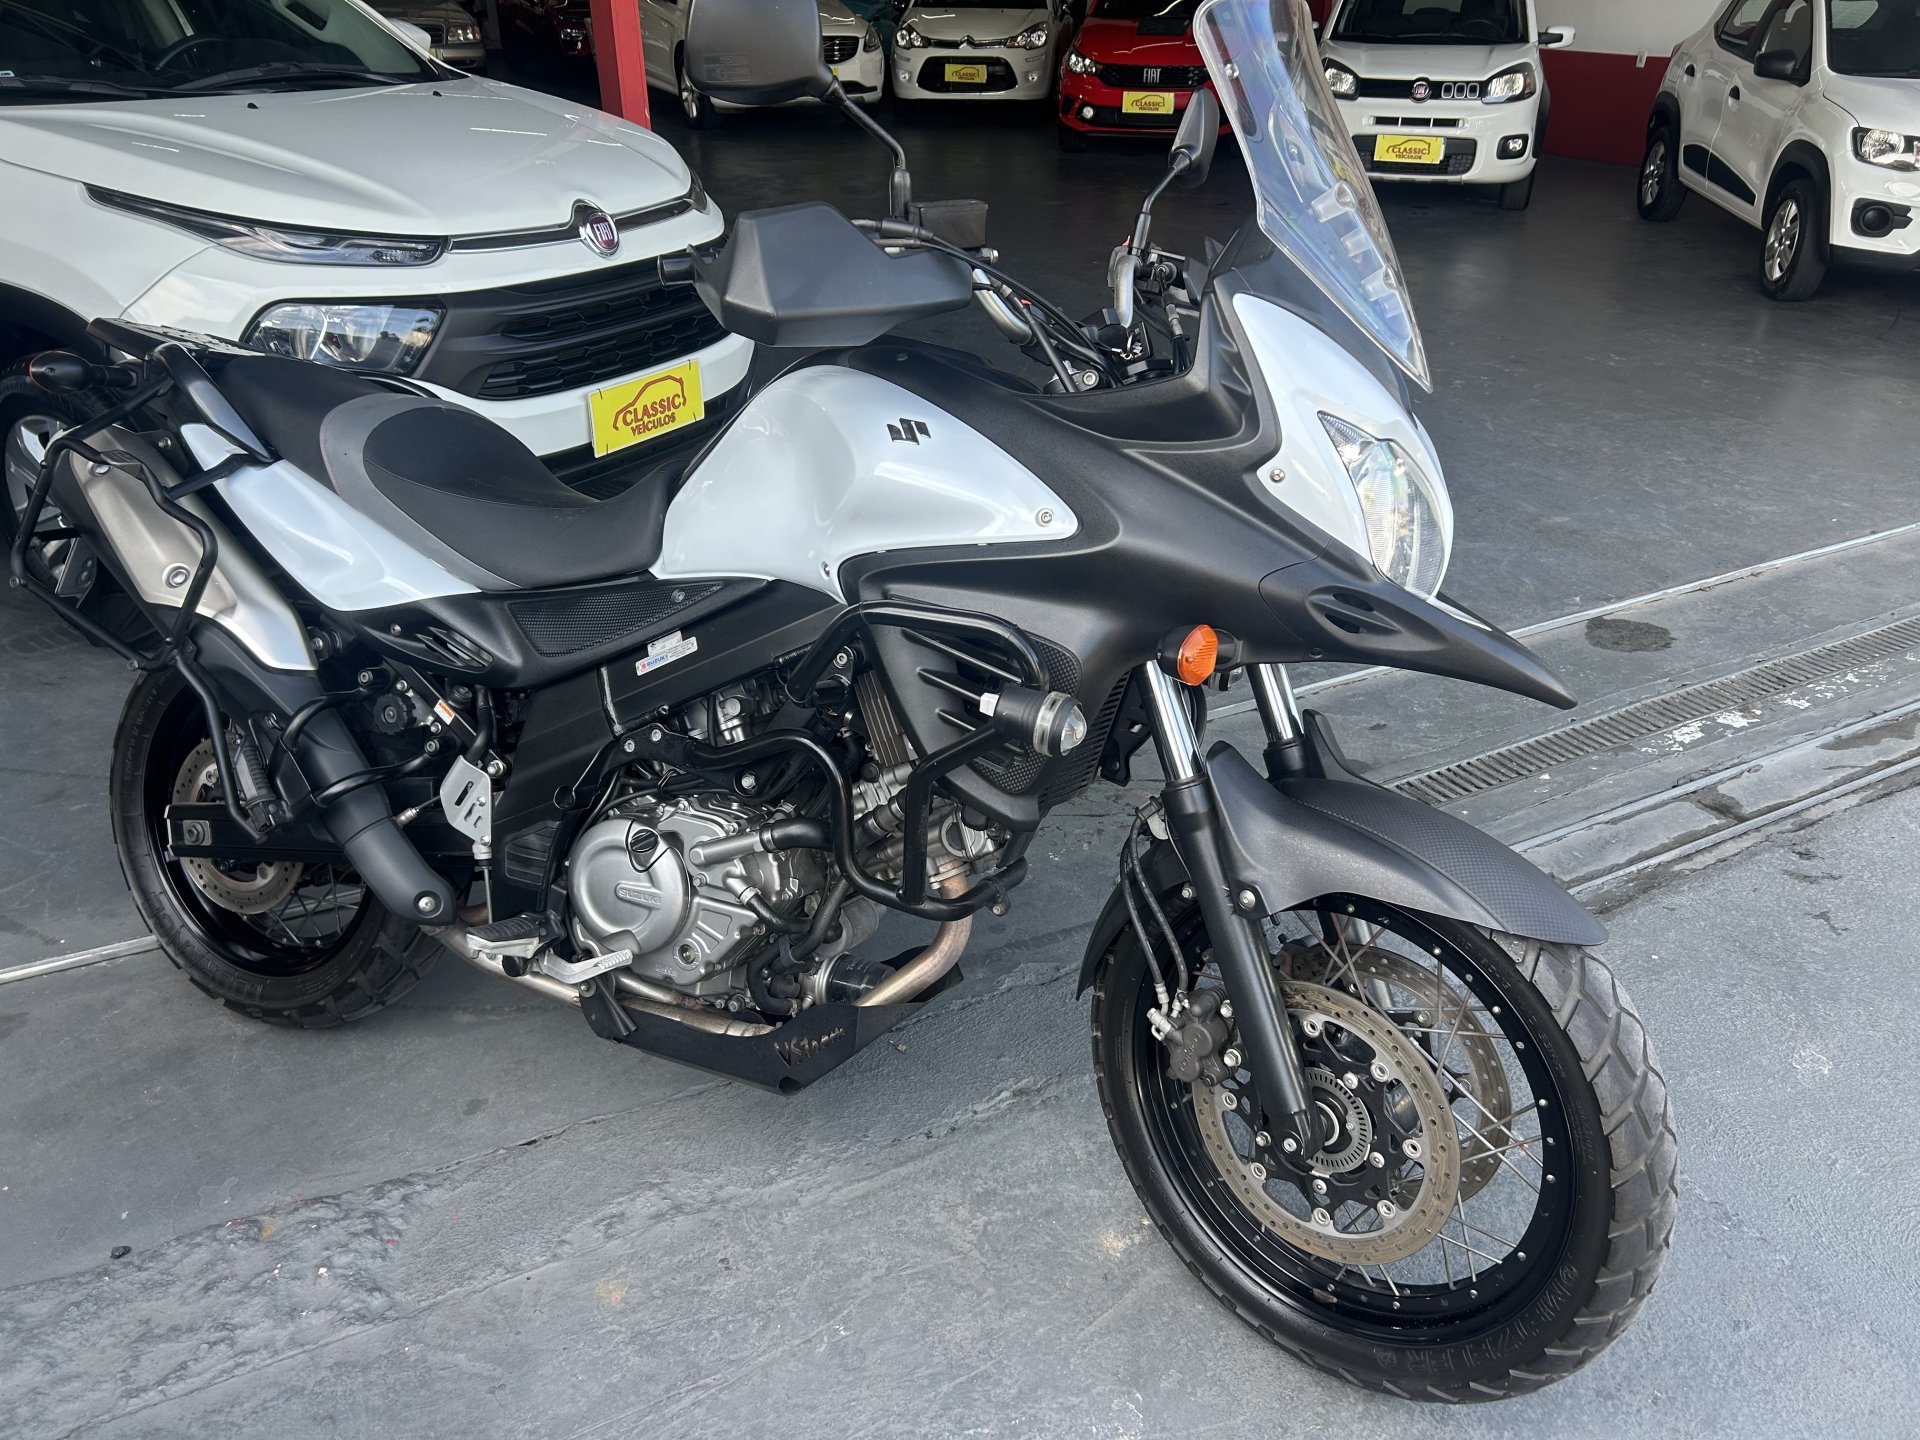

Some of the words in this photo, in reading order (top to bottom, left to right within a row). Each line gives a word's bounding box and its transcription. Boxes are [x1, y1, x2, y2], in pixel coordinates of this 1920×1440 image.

[1142, 68, 1161, 83] FIAT
[1135, 100, 1163, 108] CLASSIC
[1391, 146, 1427, 155] CLASSIC
[622, 393, 682, 427] CLASSIC
